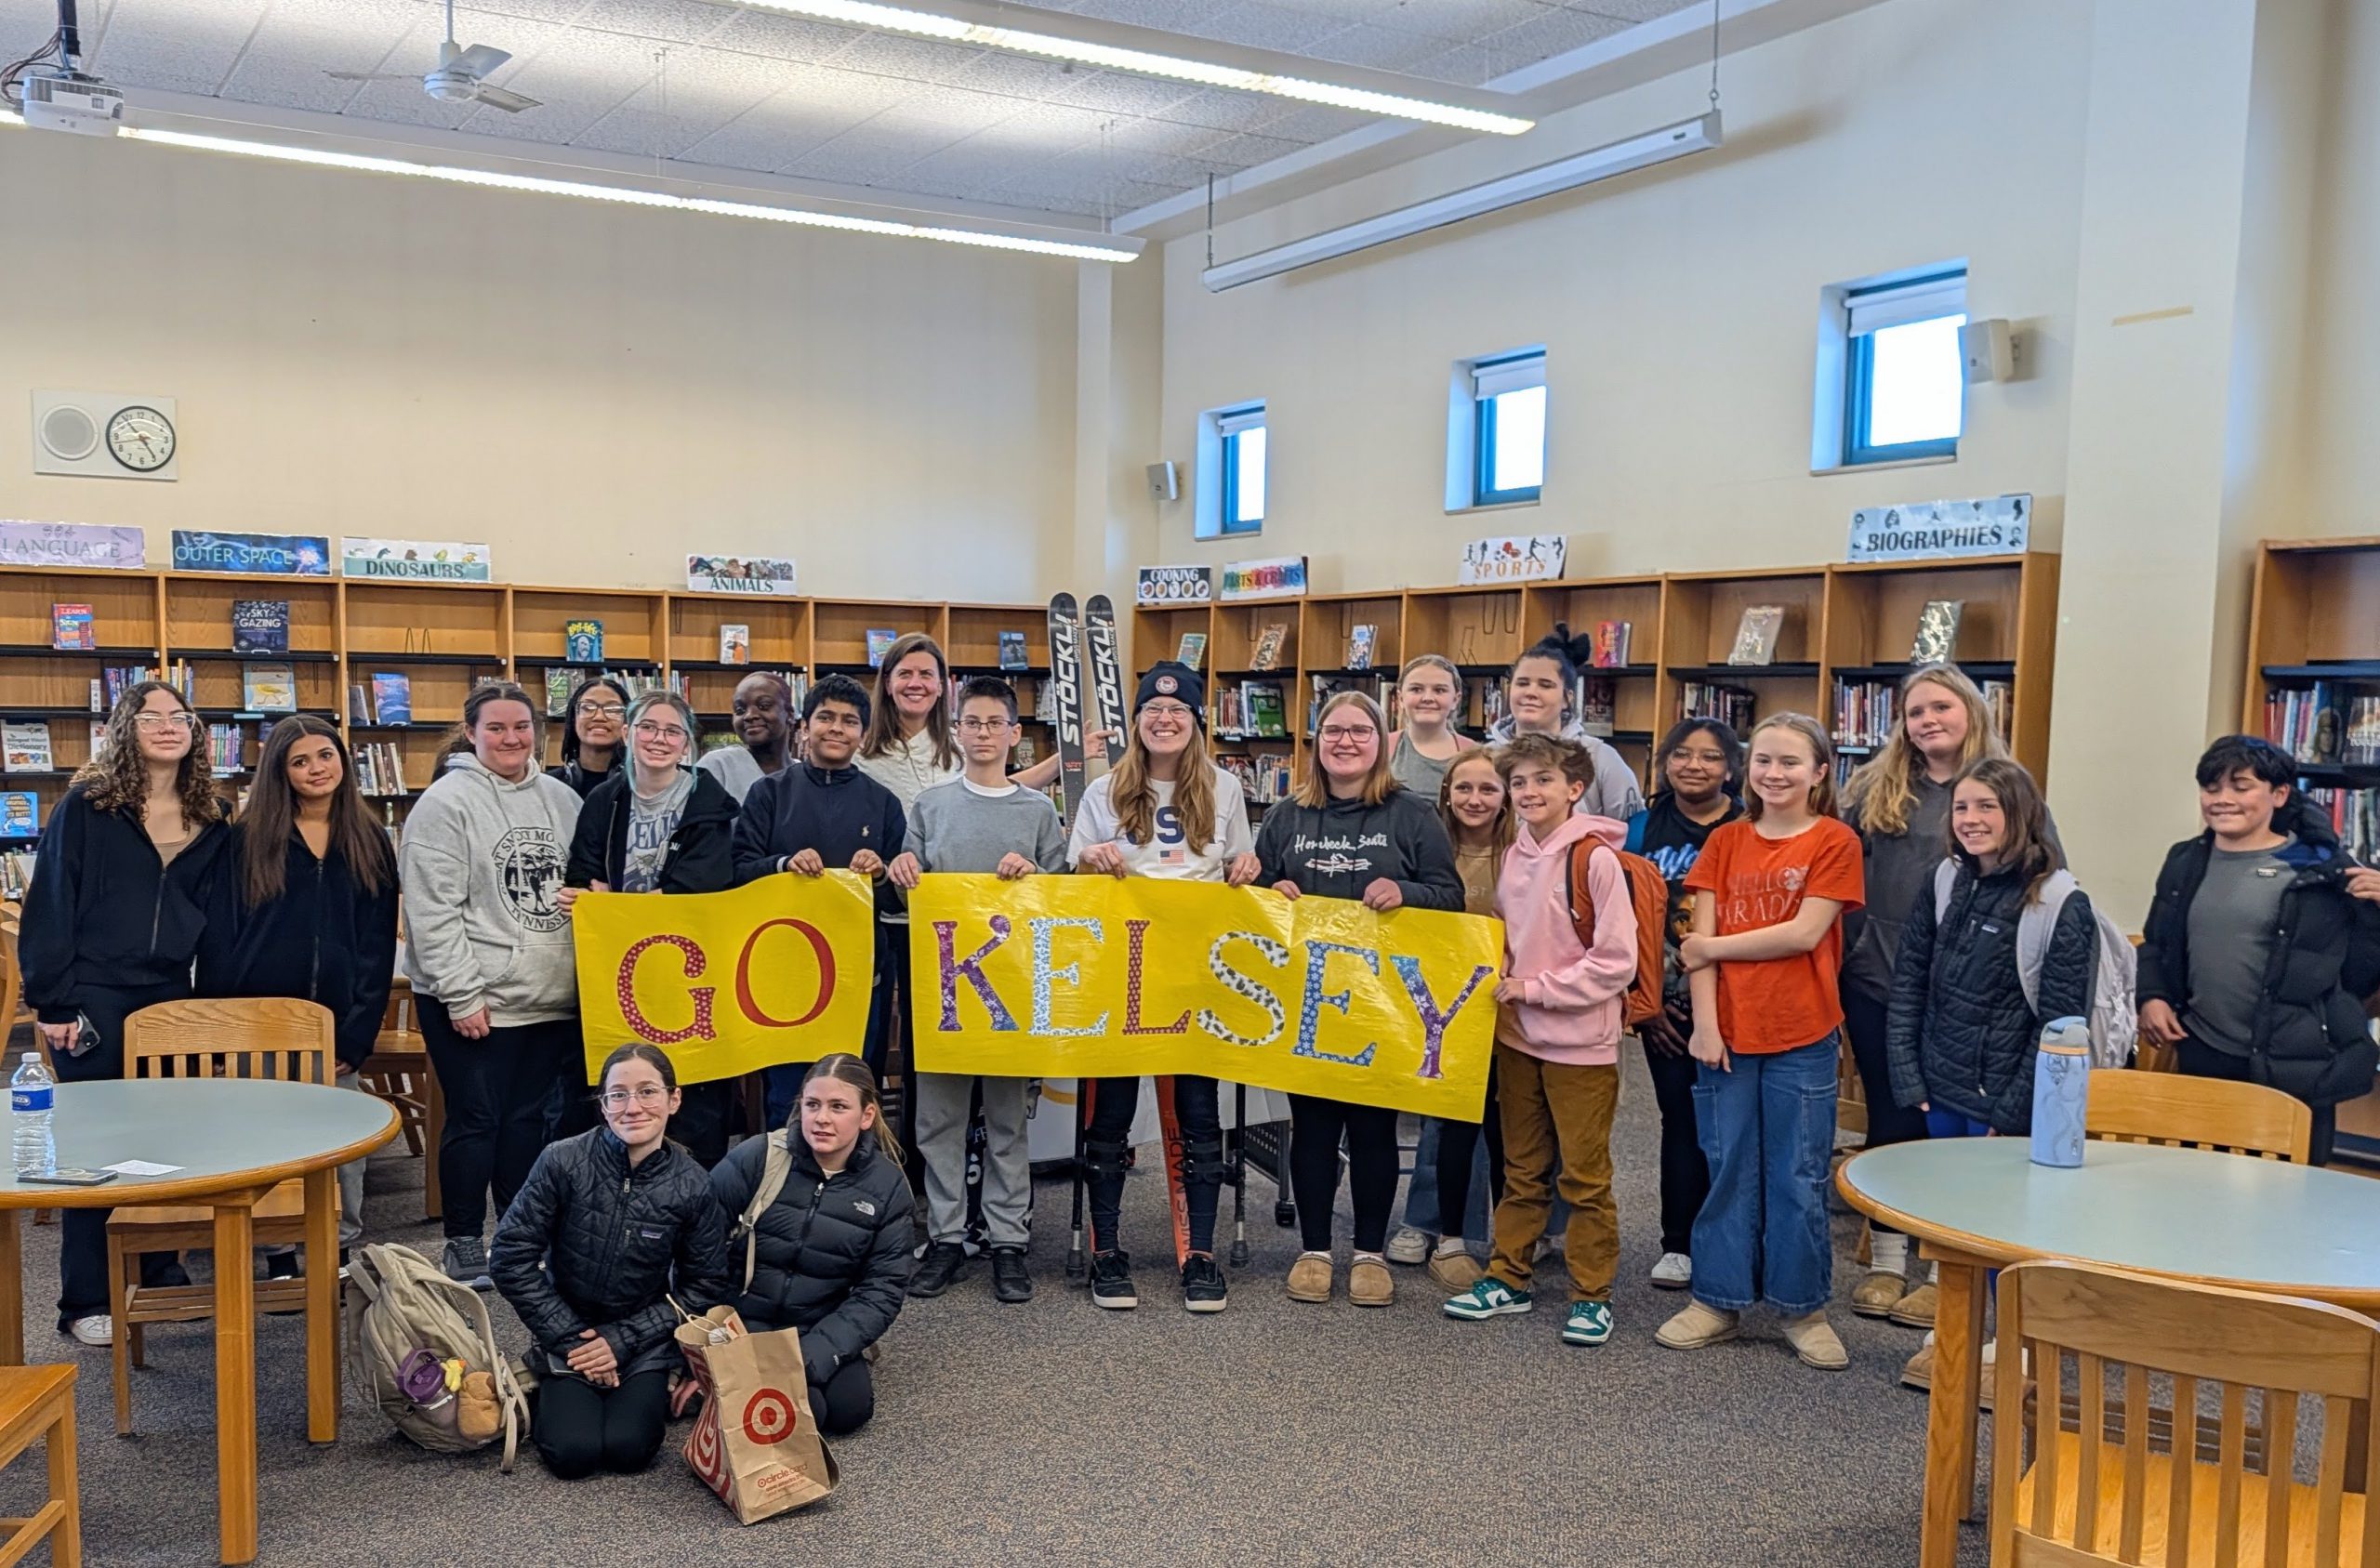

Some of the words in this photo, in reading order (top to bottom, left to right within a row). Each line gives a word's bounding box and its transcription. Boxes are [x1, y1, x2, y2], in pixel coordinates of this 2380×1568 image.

[163, 436, 169, 444] 3
[139, 456, 145, 465] 6
[2, 536, 121, 559] LANGUAGE
[1866, 524, 2003, 552] BIOGRAPHIES
[175, 545, 233, 563] OUTER
[240, 547, 294, 566] SPACE
[365, 560, 465, 579] DINOSAURS
[1150, 568, 1199, 582] COOKING
[1474, 560, 1547, 580] SPORTS
[710, 577, 774, 593] ANIMALS
[239, 618, 282, 628] GAZING
[250, 608, 271, 618] SKY
[1054, 613, 1080, 747] STÖCKLI
[1091, 615, 1126, 748] STÖCKLI
[615, 917, 837, 1045] GO
[937, 914, 1495, 1080] KELSEY
[766, 1469, 789, 1483] circle
[790, 1462, 808, 1474] card
